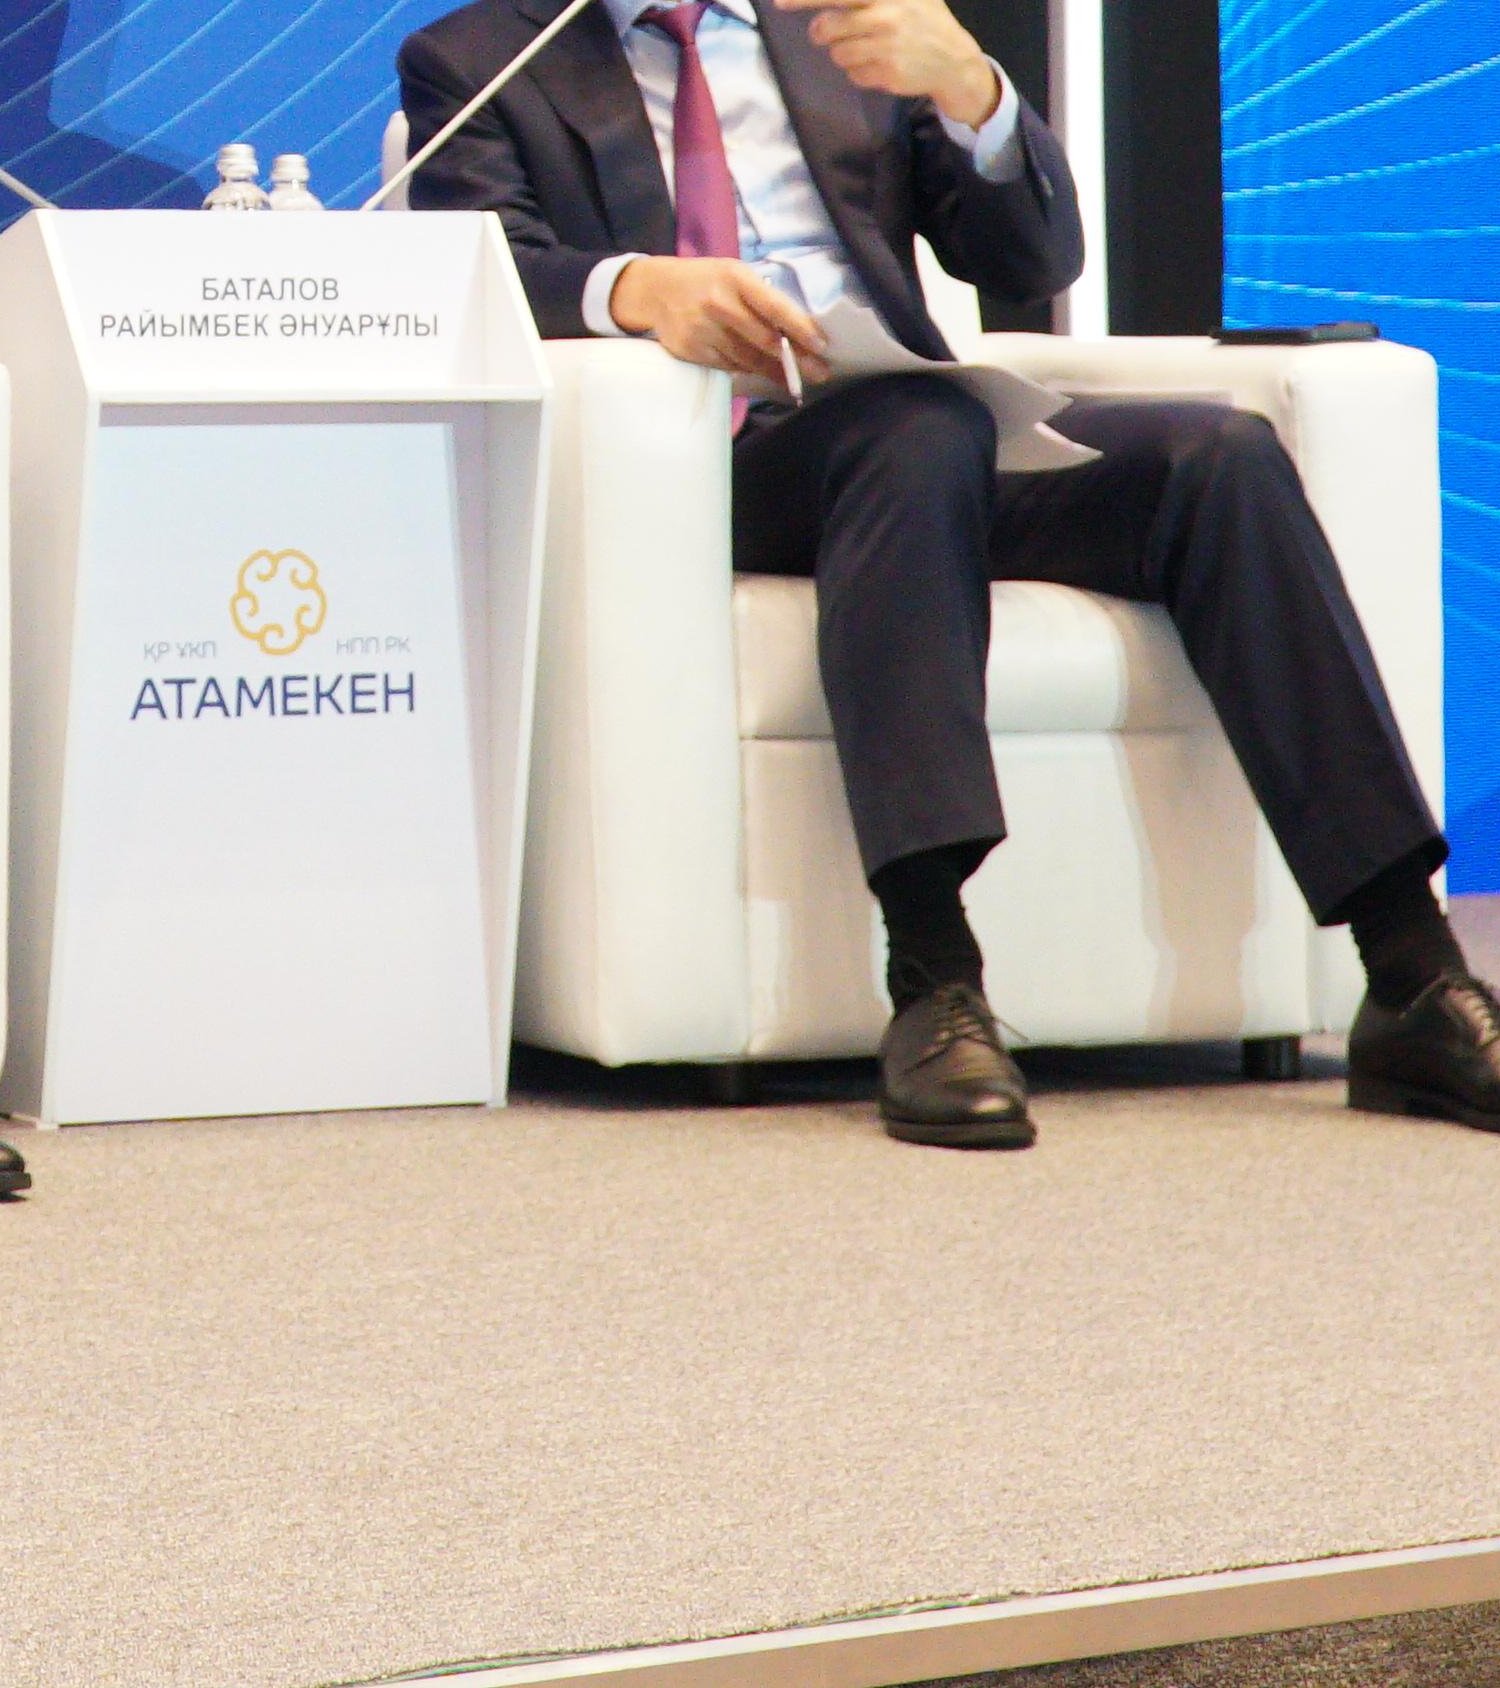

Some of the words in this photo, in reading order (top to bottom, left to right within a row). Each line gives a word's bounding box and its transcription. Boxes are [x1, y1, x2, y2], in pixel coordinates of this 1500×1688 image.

[201, 277, 340, 301] БАТАЛОВ
[99, 309, 269, 338] РАЙЫМБЕК
[278, 313, 439, 338] ӘНУАРҰЛЫ
[334, 634, 382, 656] НПП
[129, 671, 416, 721] АТАМЕКЕН
